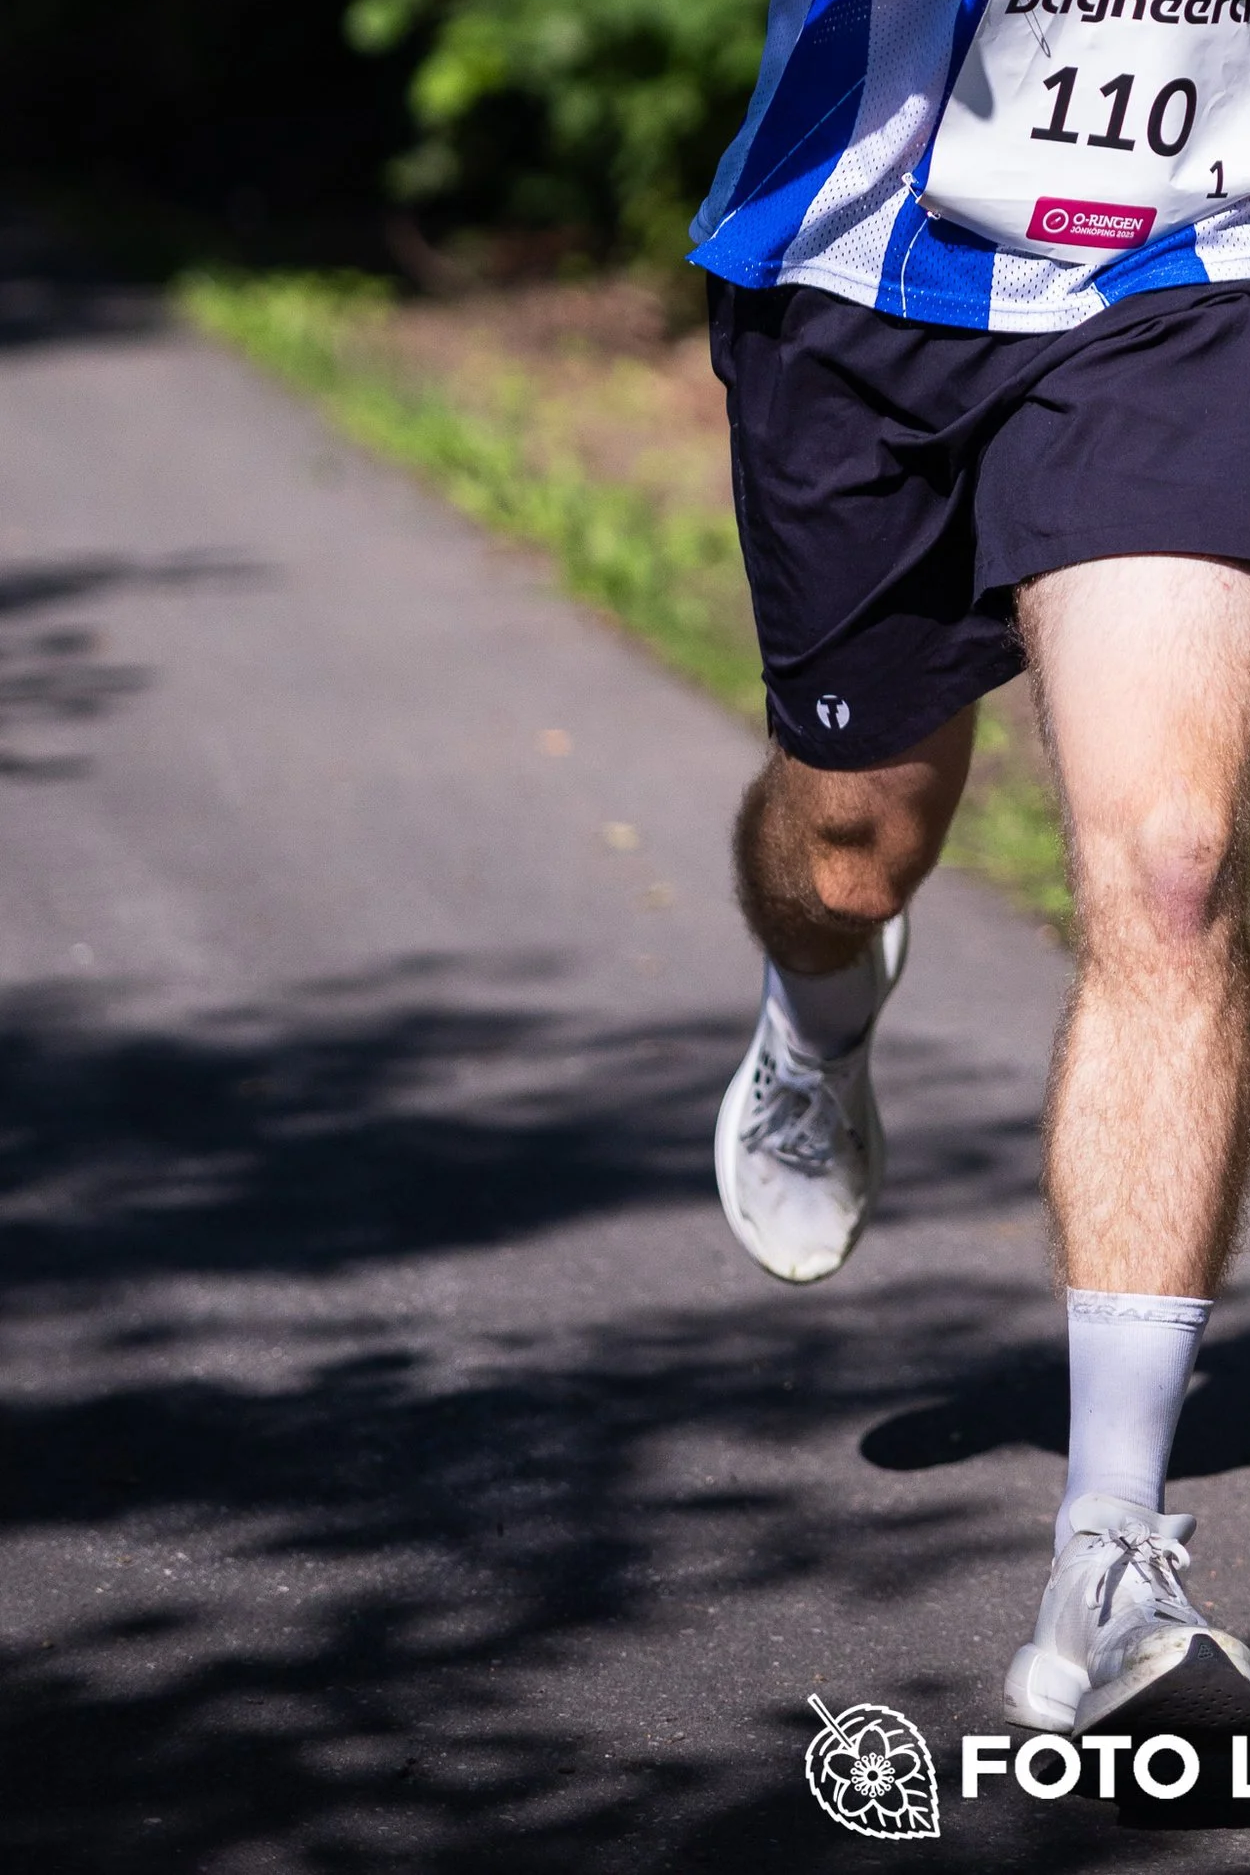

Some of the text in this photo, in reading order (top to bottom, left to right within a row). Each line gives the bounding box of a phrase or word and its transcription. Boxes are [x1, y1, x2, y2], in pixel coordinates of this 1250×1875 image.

[1030, 66, 1197, 157] 110
[1206, 160, 1228, 198] 1
[1073, 213, 1143, 230] O-RINGEN
